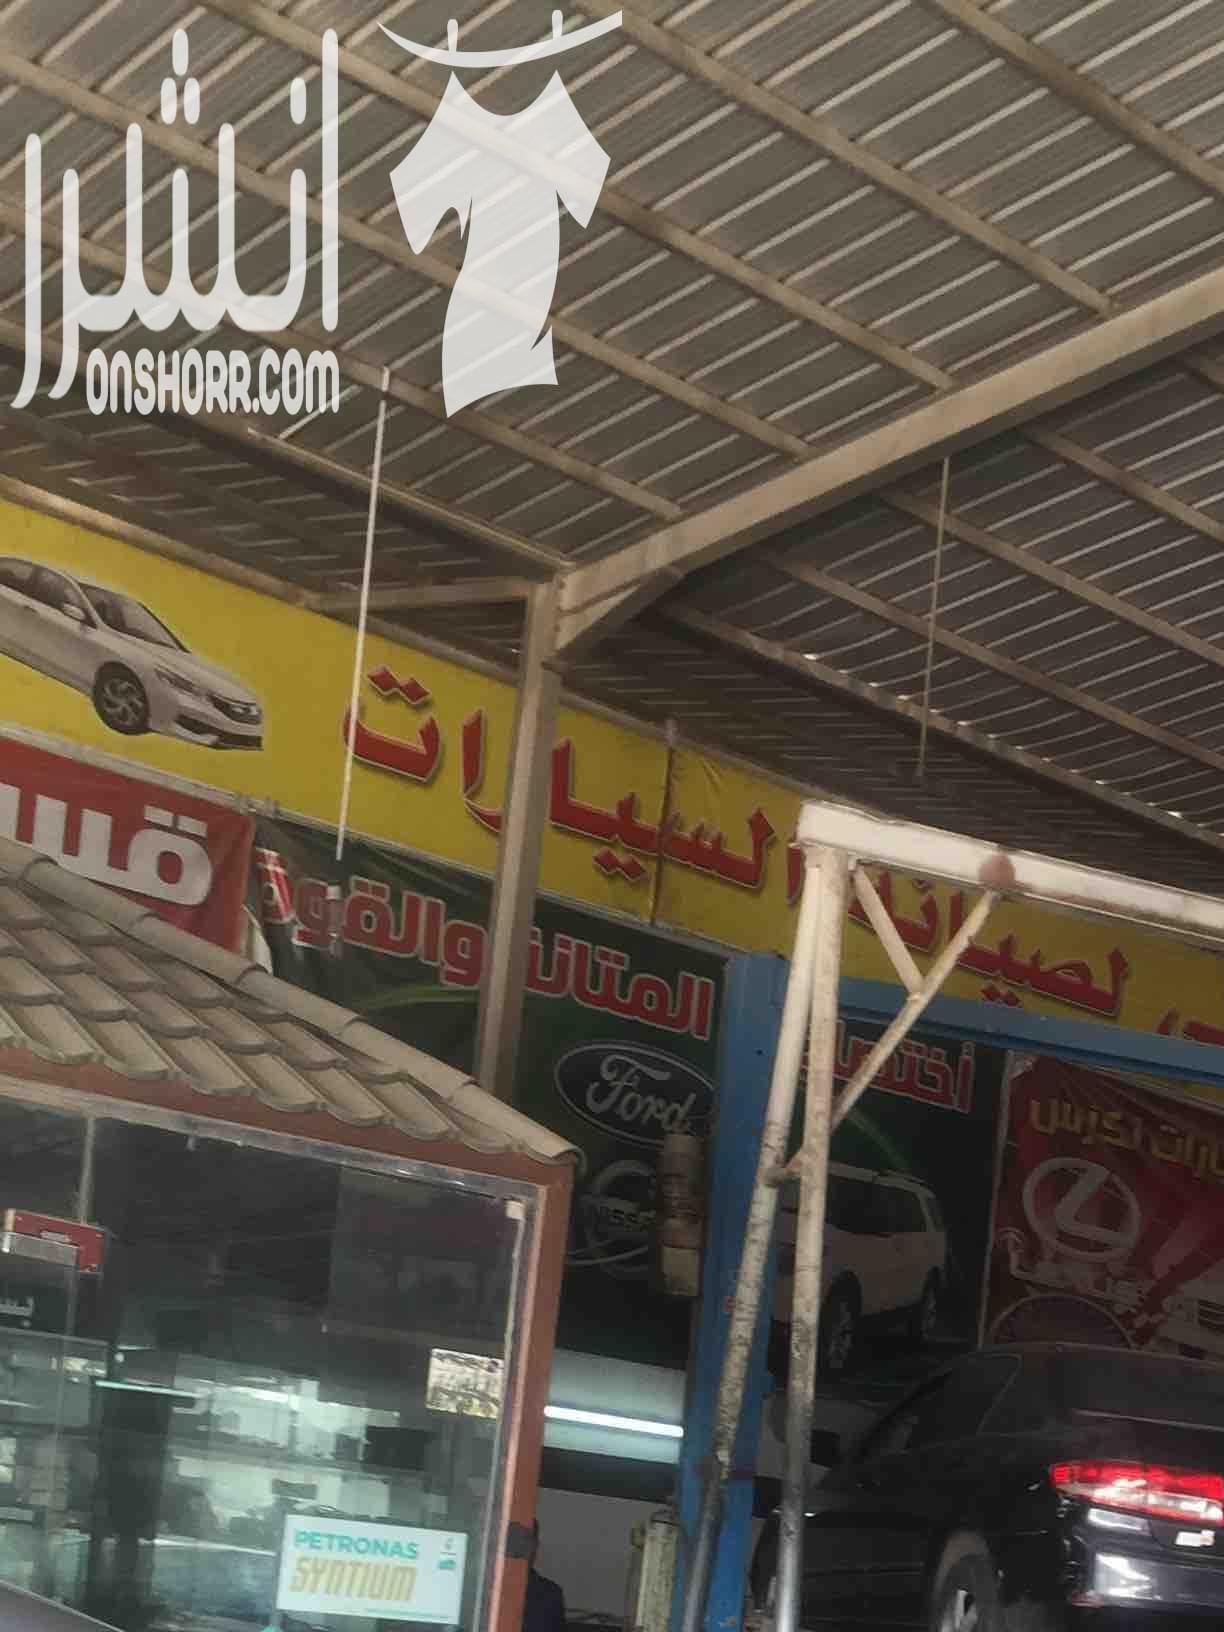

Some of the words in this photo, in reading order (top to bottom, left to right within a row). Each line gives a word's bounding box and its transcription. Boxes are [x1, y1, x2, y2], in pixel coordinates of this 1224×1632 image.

[525, 924, 715, 1041] المتان
[585, 1052, 698, 1135] Ford
[294, 1528, 420, 1561] PETRONAS
[288, 1554, 417, 1602] SYNTIUM
